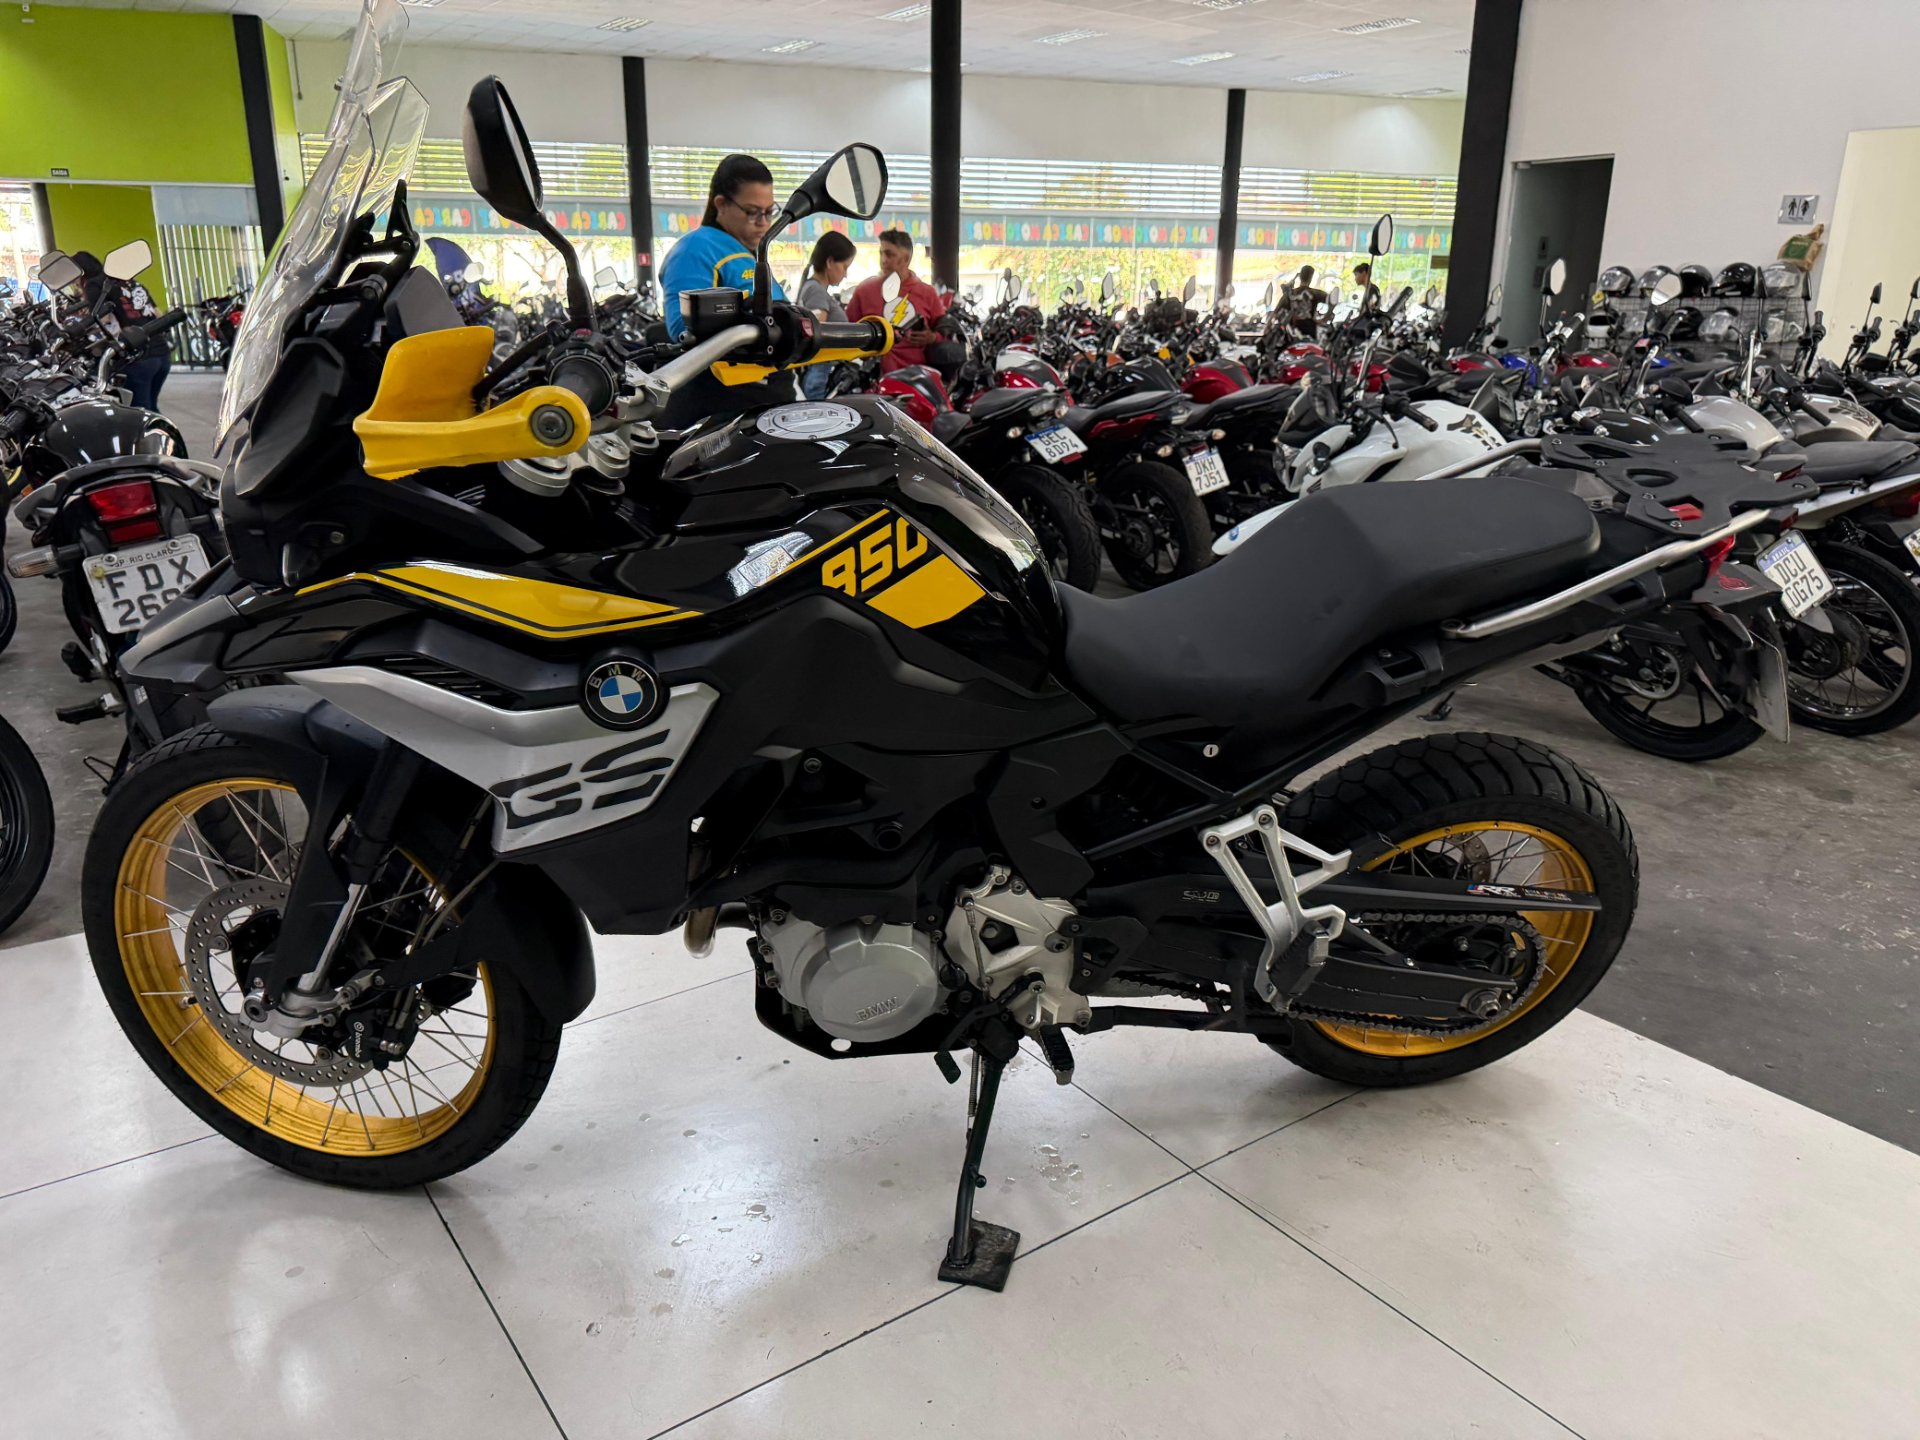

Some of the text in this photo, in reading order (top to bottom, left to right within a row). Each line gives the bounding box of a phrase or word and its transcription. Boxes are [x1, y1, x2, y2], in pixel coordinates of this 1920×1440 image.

[1194, 457, 1216, 475] DKH
[1195, 470, 1224, 490] 7J51
[104, 555, 197, 599] FDX
[1773, 550, 1807, 585] DCU
[588, 663, 647, 689] BMW
[490, 729, 675, 830] GS
[855, 996, 898, 1022] BMW
